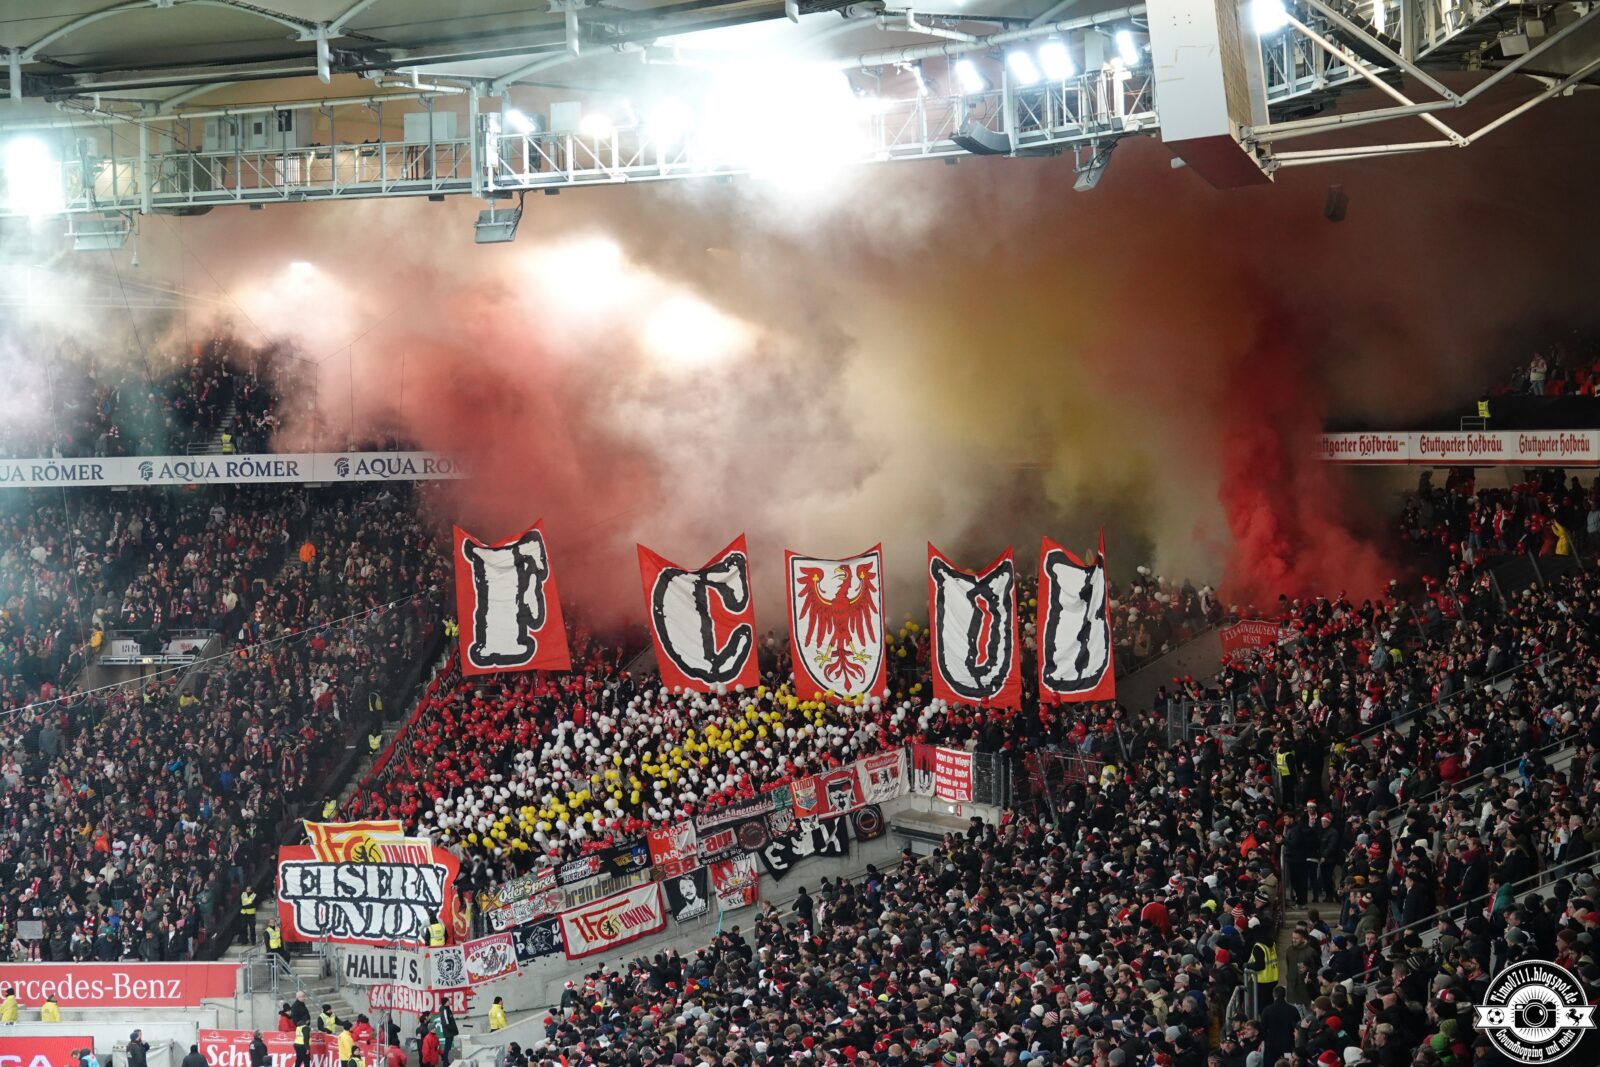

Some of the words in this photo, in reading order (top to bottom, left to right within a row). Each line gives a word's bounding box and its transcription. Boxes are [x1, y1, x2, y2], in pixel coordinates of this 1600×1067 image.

[1358, 434, 1399, 456] Hofbräu
[1419, 435, 1466, 457] Stuttgarter
[1466, 434, 1503, 456] Hofbräu
[1518, 434, 1558, 456] Stuttgarter
[1560, 433, 1590, 456] Hofbräu
[31, 461, 104, 481] RÖMER
[159, 461, 219, 481] AQUA
[226, 457, 300, 477] RÖMER
[355, 458, 417, 477] AQUA
[651, 551, 752, 685] C
[792, 778, 815, 791] UNION
[696, 800, 775, 826] Oberschöneweide
[653, 823, 690, 840] GARDE
[282, 861, 447, 904] EISERN
[500, 885, 525, 902] Oder
[525, 875, 556, 893] Spree
[619, 904, 657, 929] UNION
[346, 954, 398, 979] HALLE
[409, 959, 422, 984] S.
[0, 972, 182, 1000] ercedes-Benz
[371, 985, 466, 1013] SACHSENADLER
